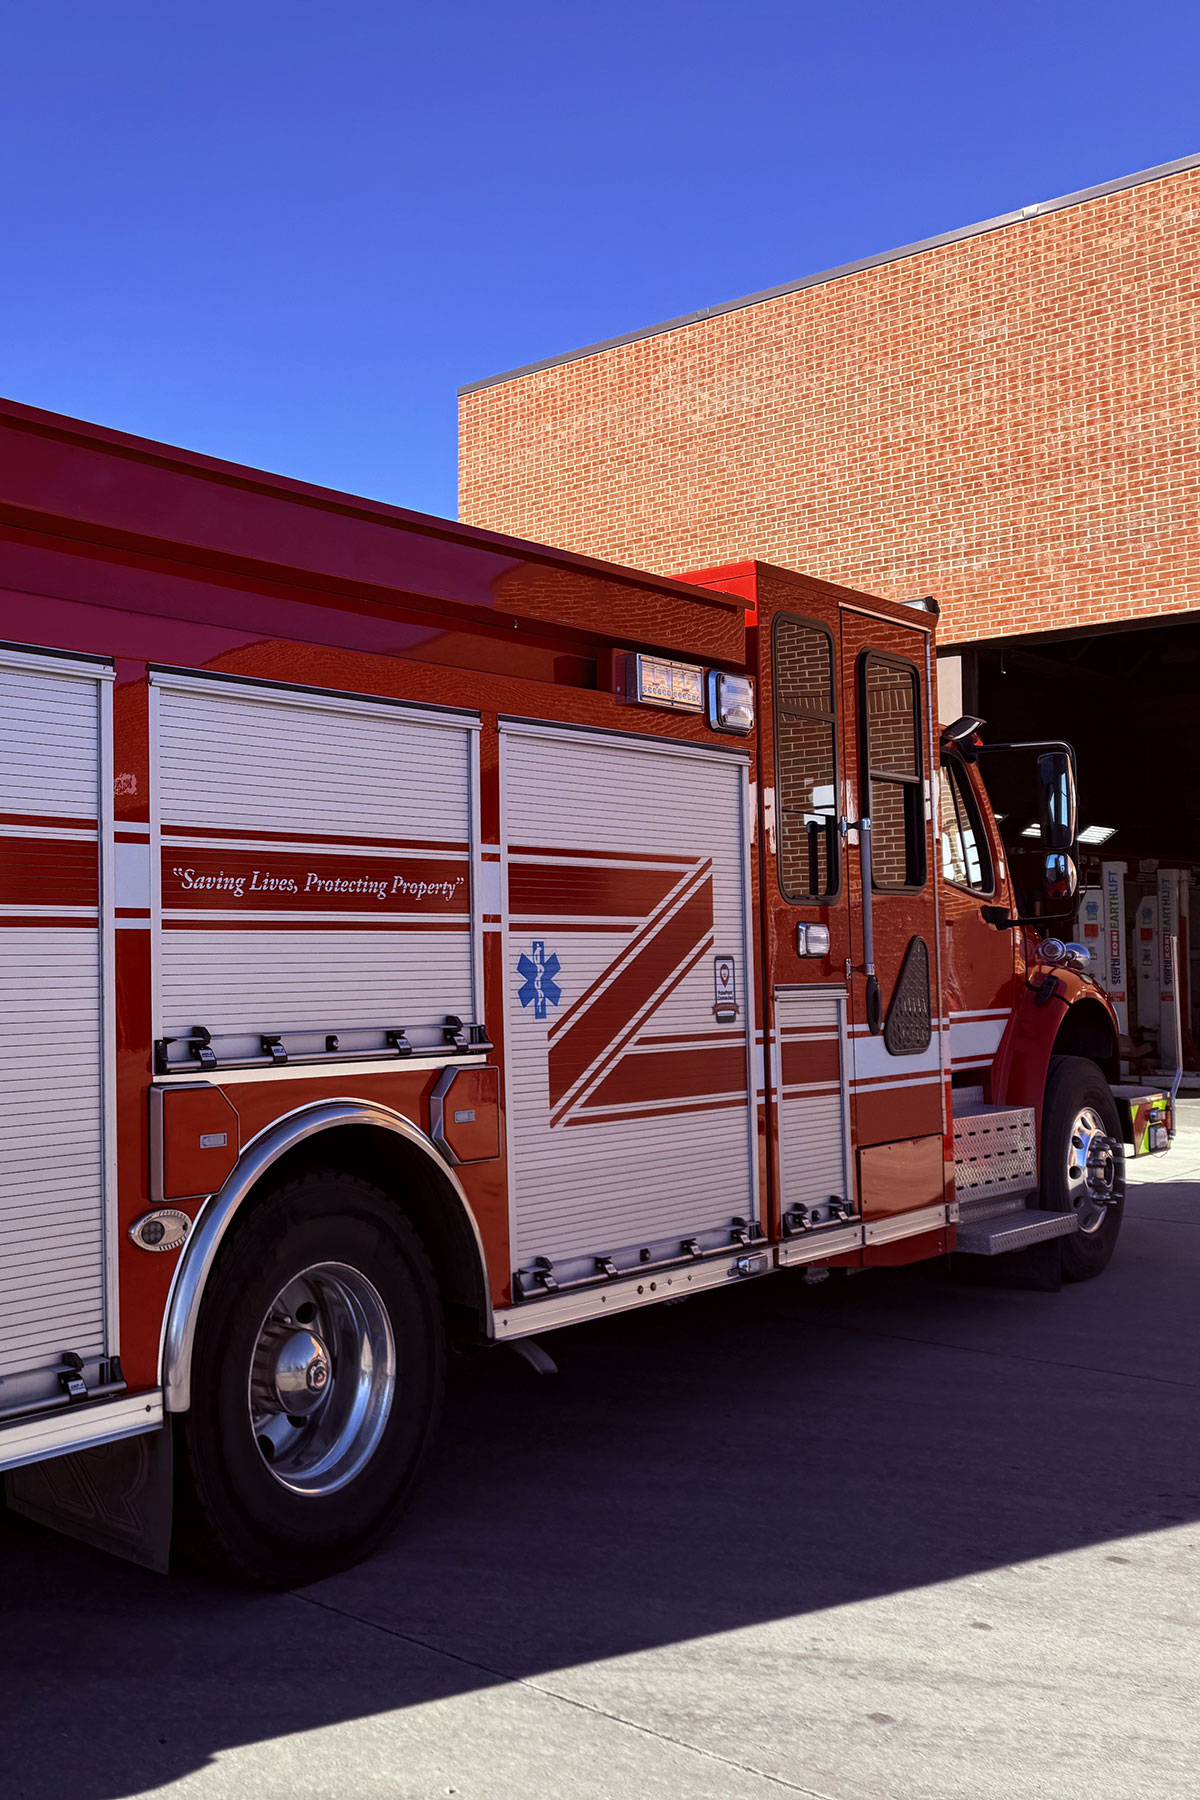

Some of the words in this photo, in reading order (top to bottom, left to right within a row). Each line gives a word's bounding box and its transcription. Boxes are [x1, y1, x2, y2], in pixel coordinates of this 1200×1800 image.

[248, 870, 299, 895] Lives,
[303, 872, 389, 900] Protecting
[1108, 871, 1119, 929] EARTHLIFT
[1161, 878, 1171, 933] EARTHLIFT
